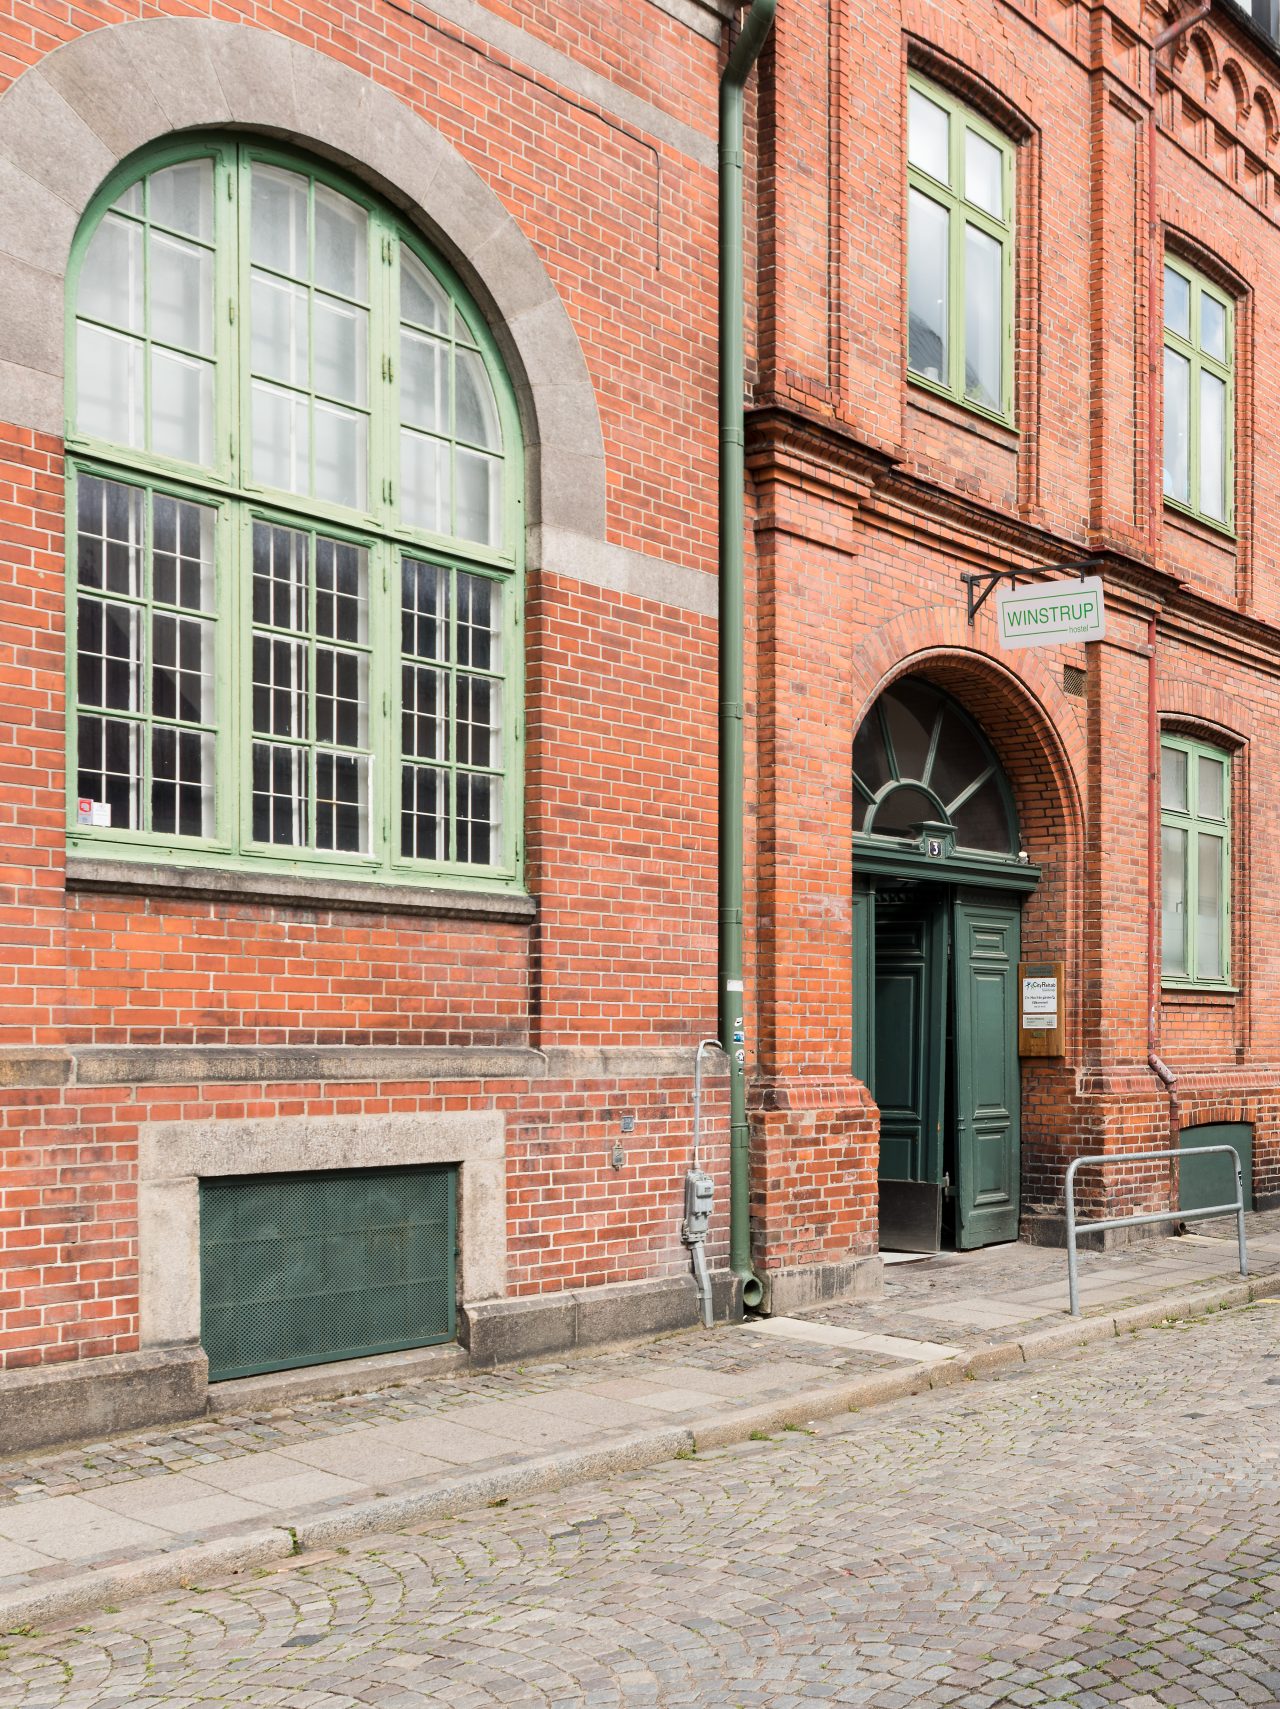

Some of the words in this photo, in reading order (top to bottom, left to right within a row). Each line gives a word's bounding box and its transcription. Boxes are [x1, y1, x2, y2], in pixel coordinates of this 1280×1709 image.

[1007, 603, 1094, 627] WINSTRUP
[1068, 624, 1089, 633] hostel
[932, 842, 939, 855] 3
